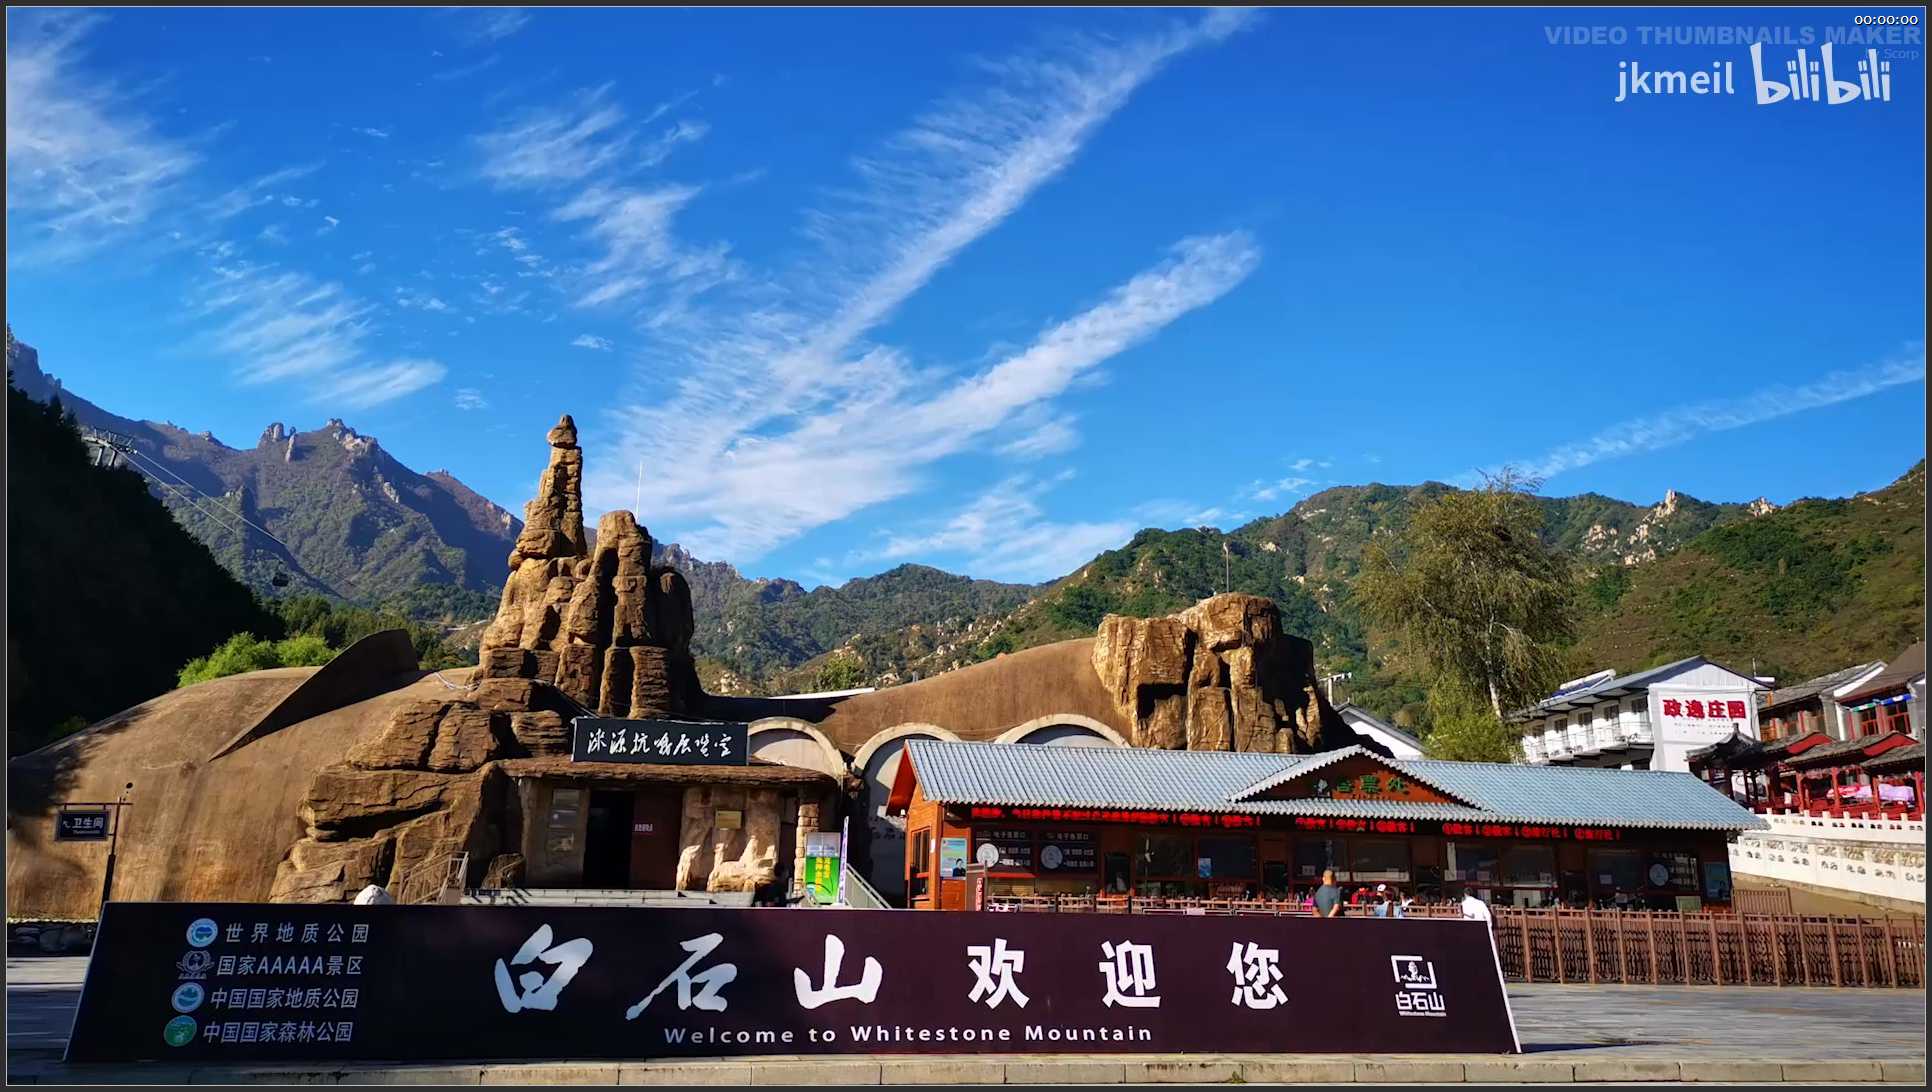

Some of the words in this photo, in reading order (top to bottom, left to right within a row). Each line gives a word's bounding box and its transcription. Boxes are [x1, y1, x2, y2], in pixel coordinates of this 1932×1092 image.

[72, 817, 104, 829] 卫生间
[224, 922, 370, 944] 世界地质公园
[216, 955, 365, 977] 国家AAAAA景区
[209, 987, 360, 1010] 中国国家地质公园
[1395, 991, 1446, 1011] 白石山
[202, 1020, 354, 1044] 中国国家森林公园
[664, 1027, 794, 1044] Welcome
[808, 1027, 836, 1043] to
[850, 1025, 1011, 1042] Whitestone
[1025, 1024, 1152, 1042] Mountain
